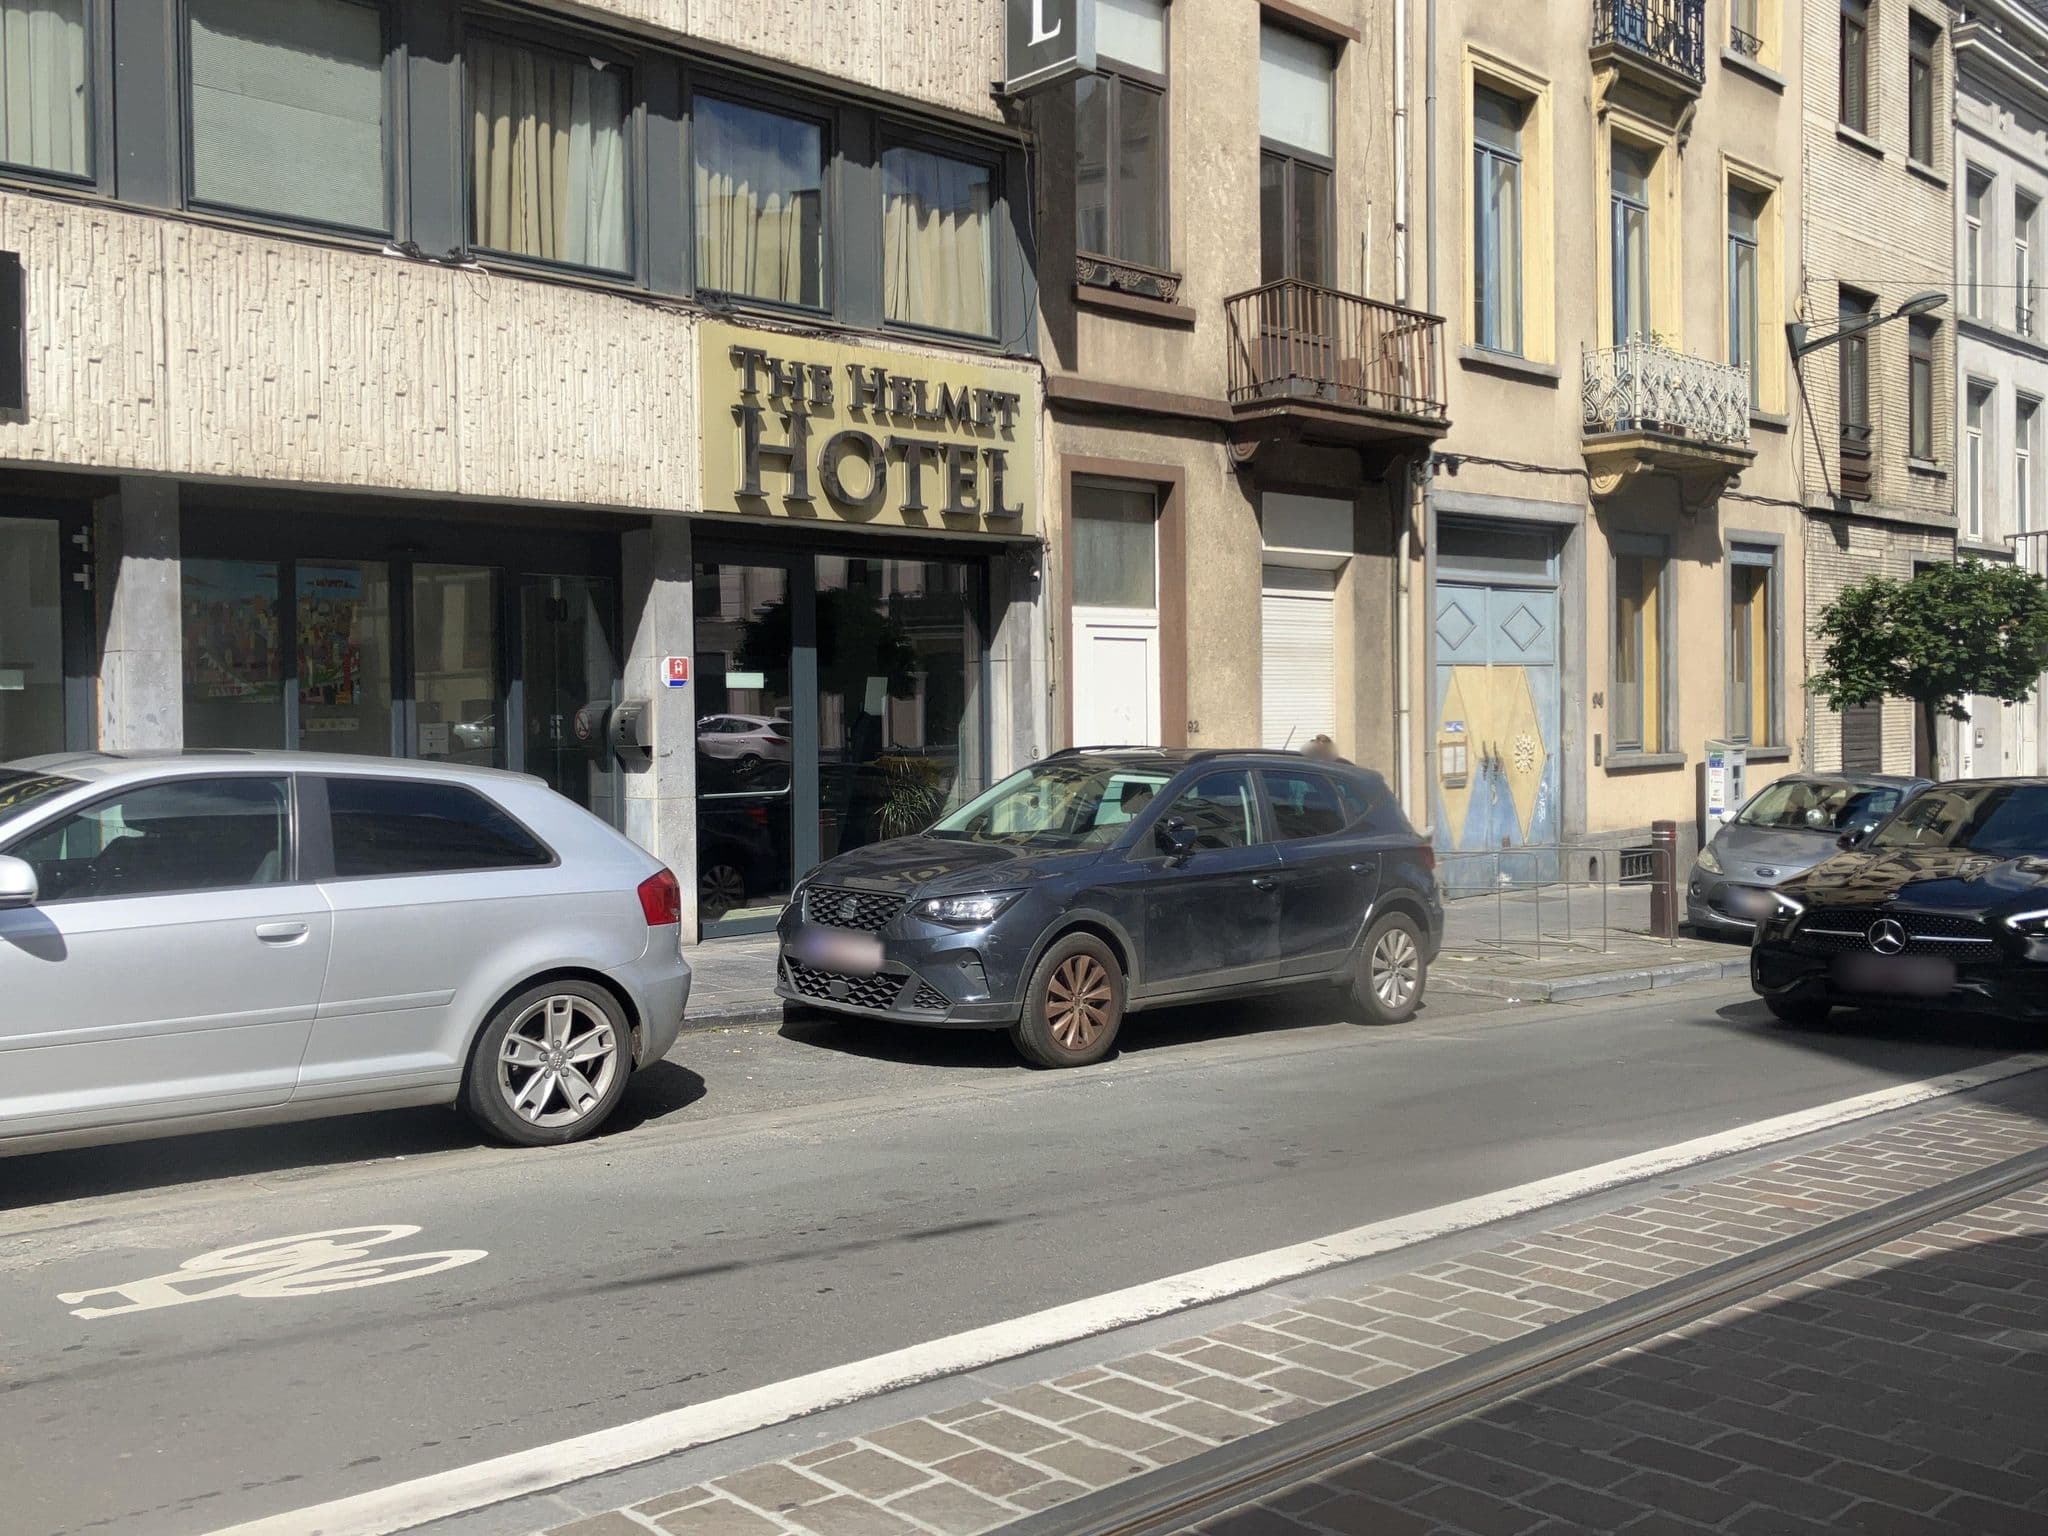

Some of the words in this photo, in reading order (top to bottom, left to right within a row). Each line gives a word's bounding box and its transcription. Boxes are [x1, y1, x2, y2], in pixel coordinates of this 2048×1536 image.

[729, 344, 834, 406] THE
[846, 363, 1021, 430] HELMET
[731, 404, 1024, 518] HOTEL
[1187, 720, 1200, 733] 92
